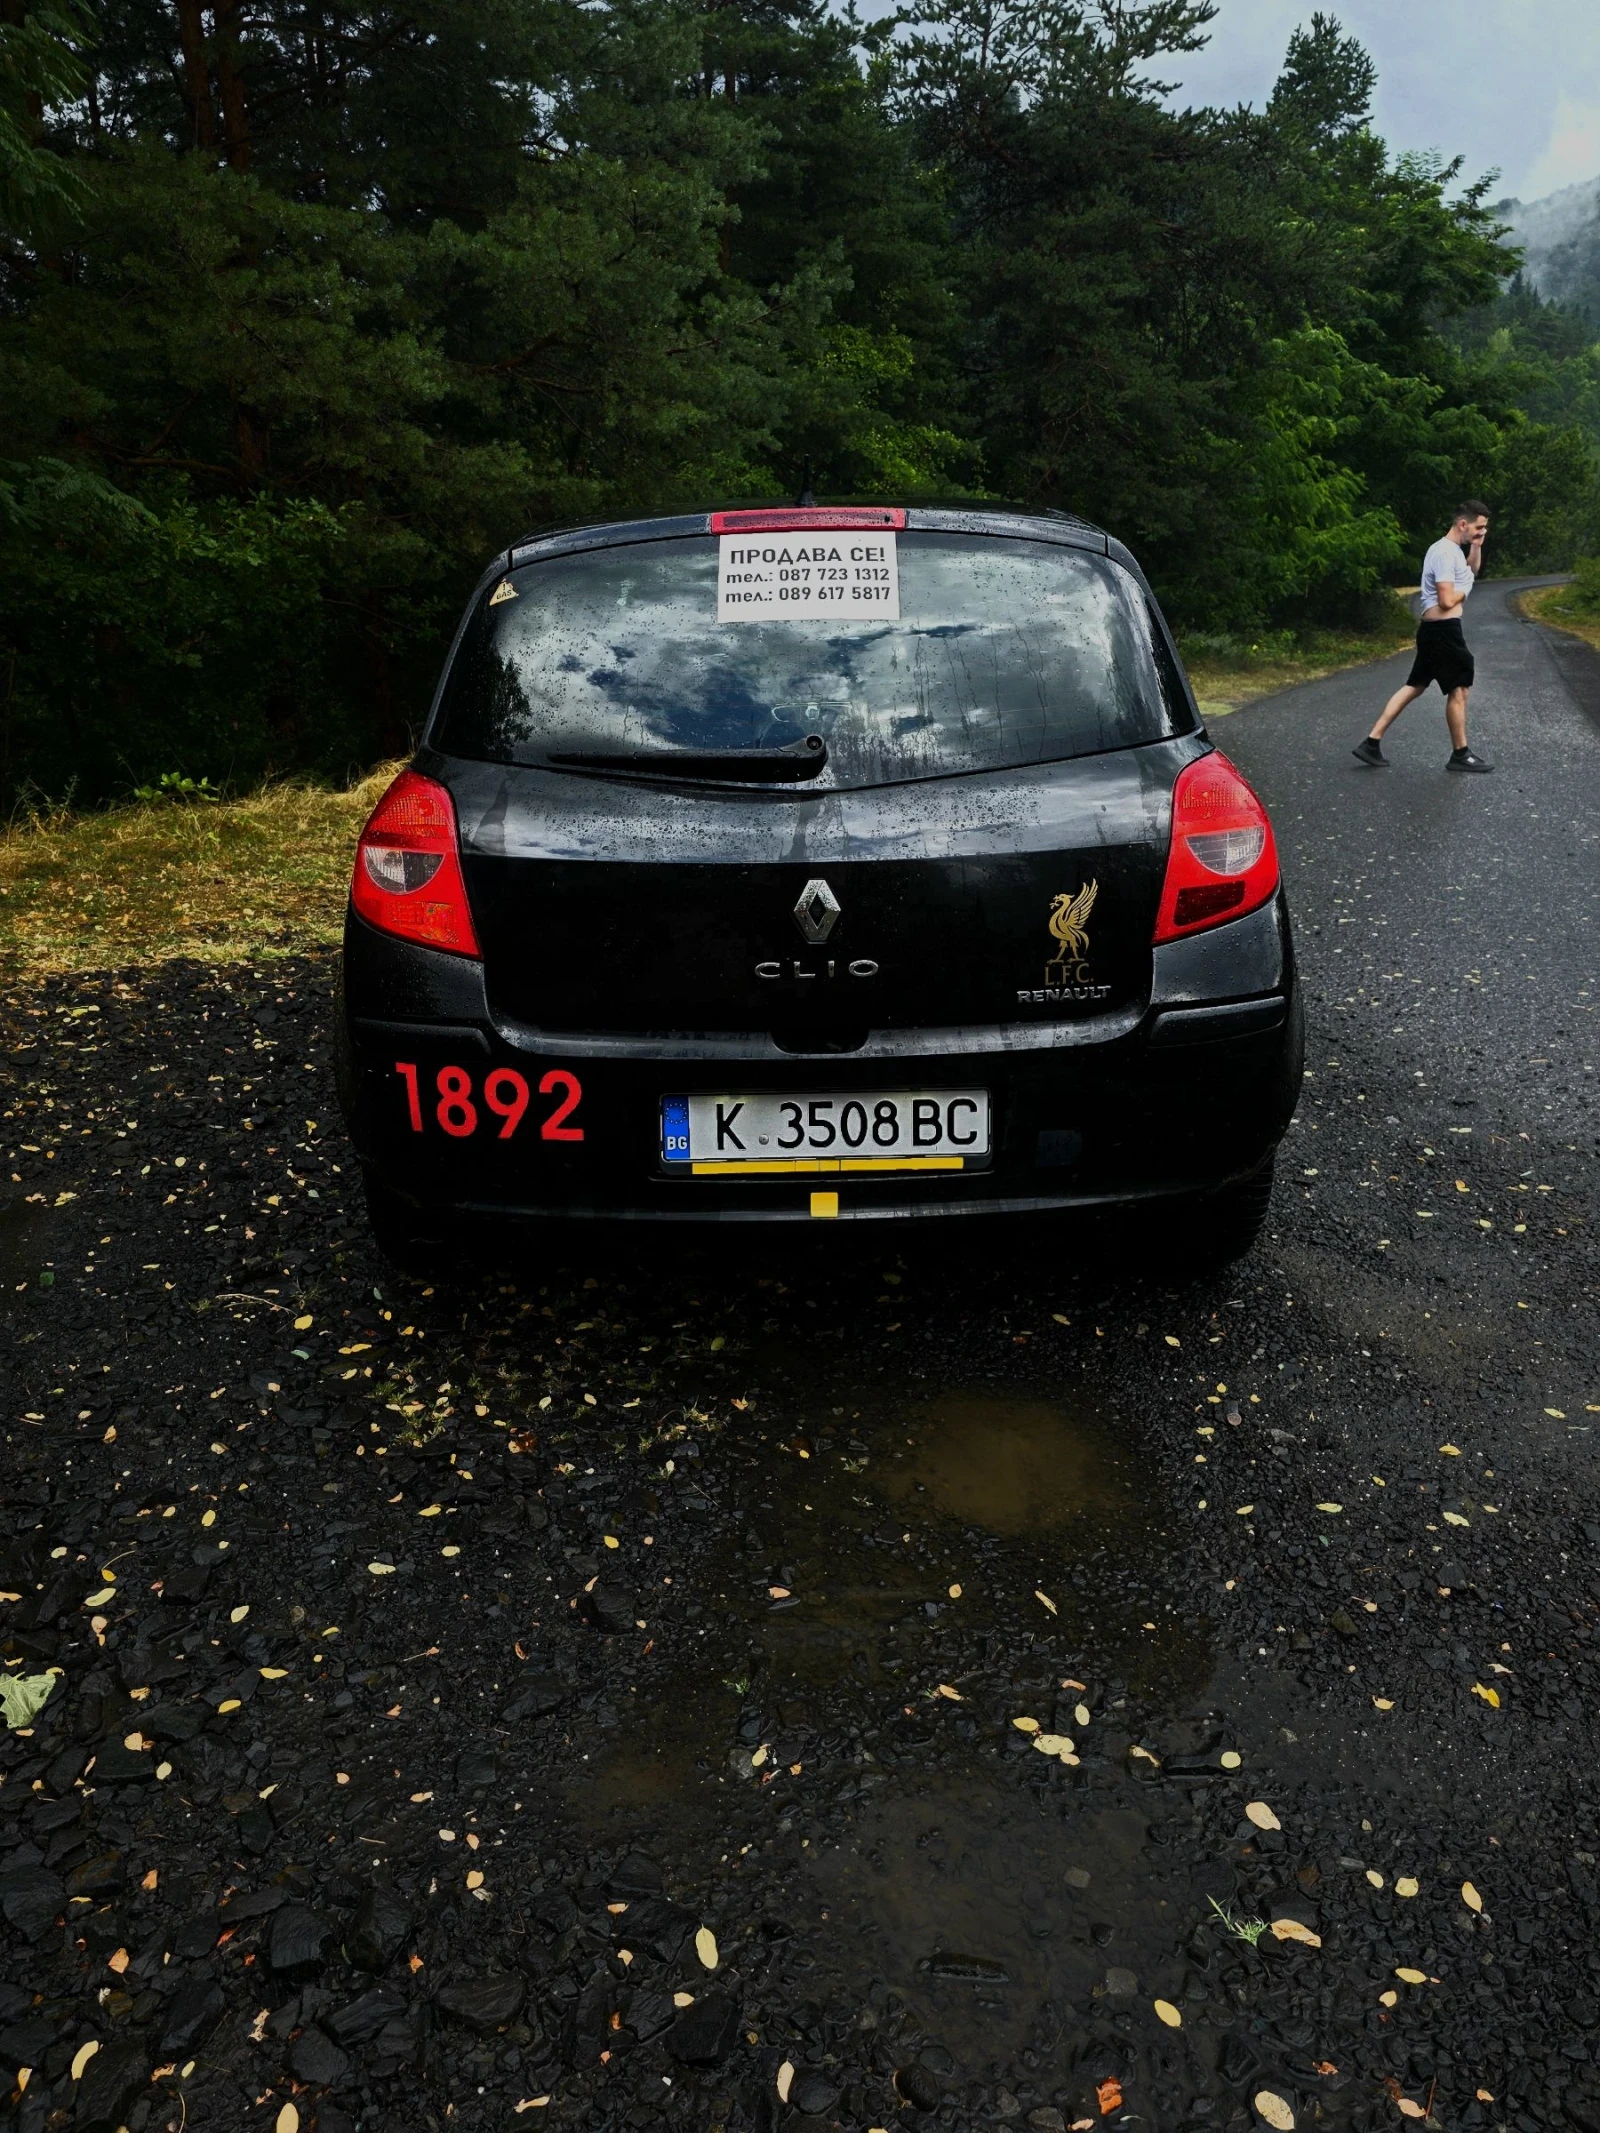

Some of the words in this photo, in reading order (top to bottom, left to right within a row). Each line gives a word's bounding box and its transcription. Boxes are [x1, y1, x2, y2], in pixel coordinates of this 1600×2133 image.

[730, 547, 842, 565] ПРОДАВА
[850, 547, 886, 562] СЕ!
[726, 572, 773, 584] тел.:
[779, 568, 811, 582] 087
[817, 568, 848, 581] 723
[855, 568, 890, 581] 1312
[725, 590, 773, 604] тел.:
[778, 587, 811, 600] 089
[818, 587, 844, 600] 617
[851, 587, 891, 600] 5817
[754, 959, 879, 979] CLIO
[1044, 962, 1095, 986] L.F.C.
[1016, 985, 1112, 1003] RENAULT
[395, 1061, 585, 1141] 1892
[715, 1102, 747, 1151] K
[777, 1100, 900, 1149] 3508
[666, 1136, 688, 1151] BG
